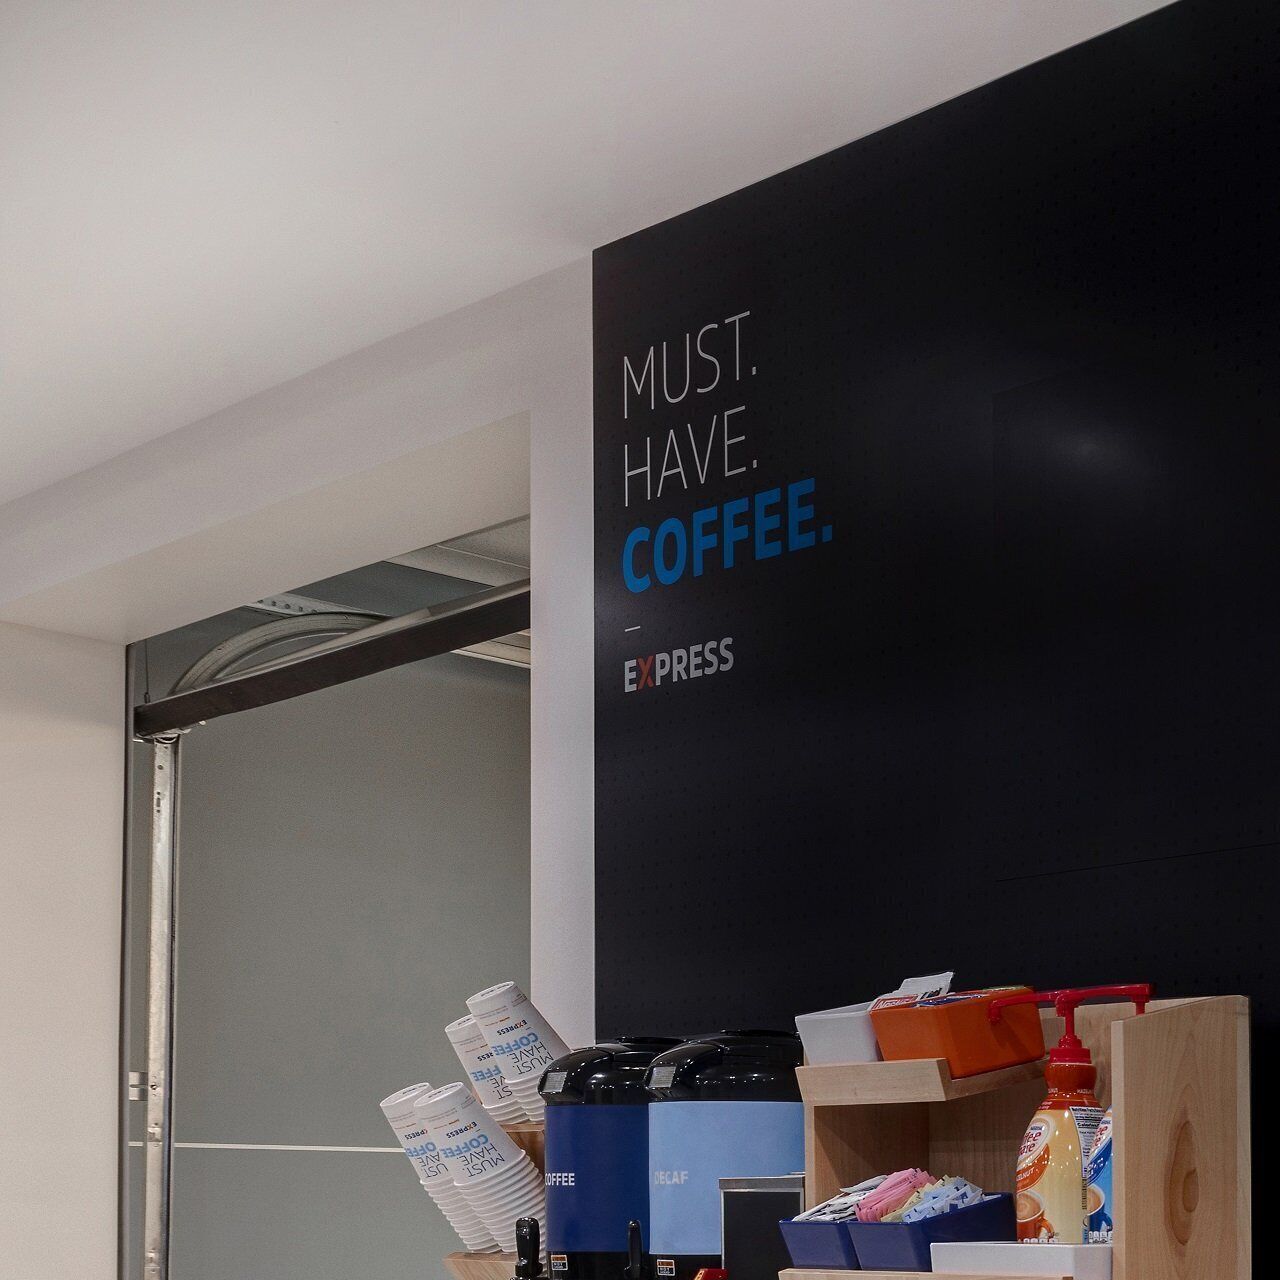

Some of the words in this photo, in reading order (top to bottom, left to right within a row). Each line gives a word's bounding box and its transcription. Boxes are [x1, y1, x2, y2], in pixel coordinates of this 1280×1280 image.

[624, 310, 757, 419] MUST.
[624, 405, 758, 507] HAVE.
[622, 477, 833, 594] COFFEE.
[624, 637, 735, 693] EXPRESS
[497, 1019, 528, 1036] EXPRESS
[507, 1041, 547, 1064] HAVE.
[512, 1051, 555, 1075] MUST.
[492, 1085, 513, 1100] ST.
[446, 1121, 478, 1138] EXPRESS
[456, 1142, 498, 1167] HAVE.
[462, 1153, 506, 1178] MUST.
[544, 1172, 576, 1186] COFFEE
[654, 1170, 688, 1185] DECAF
